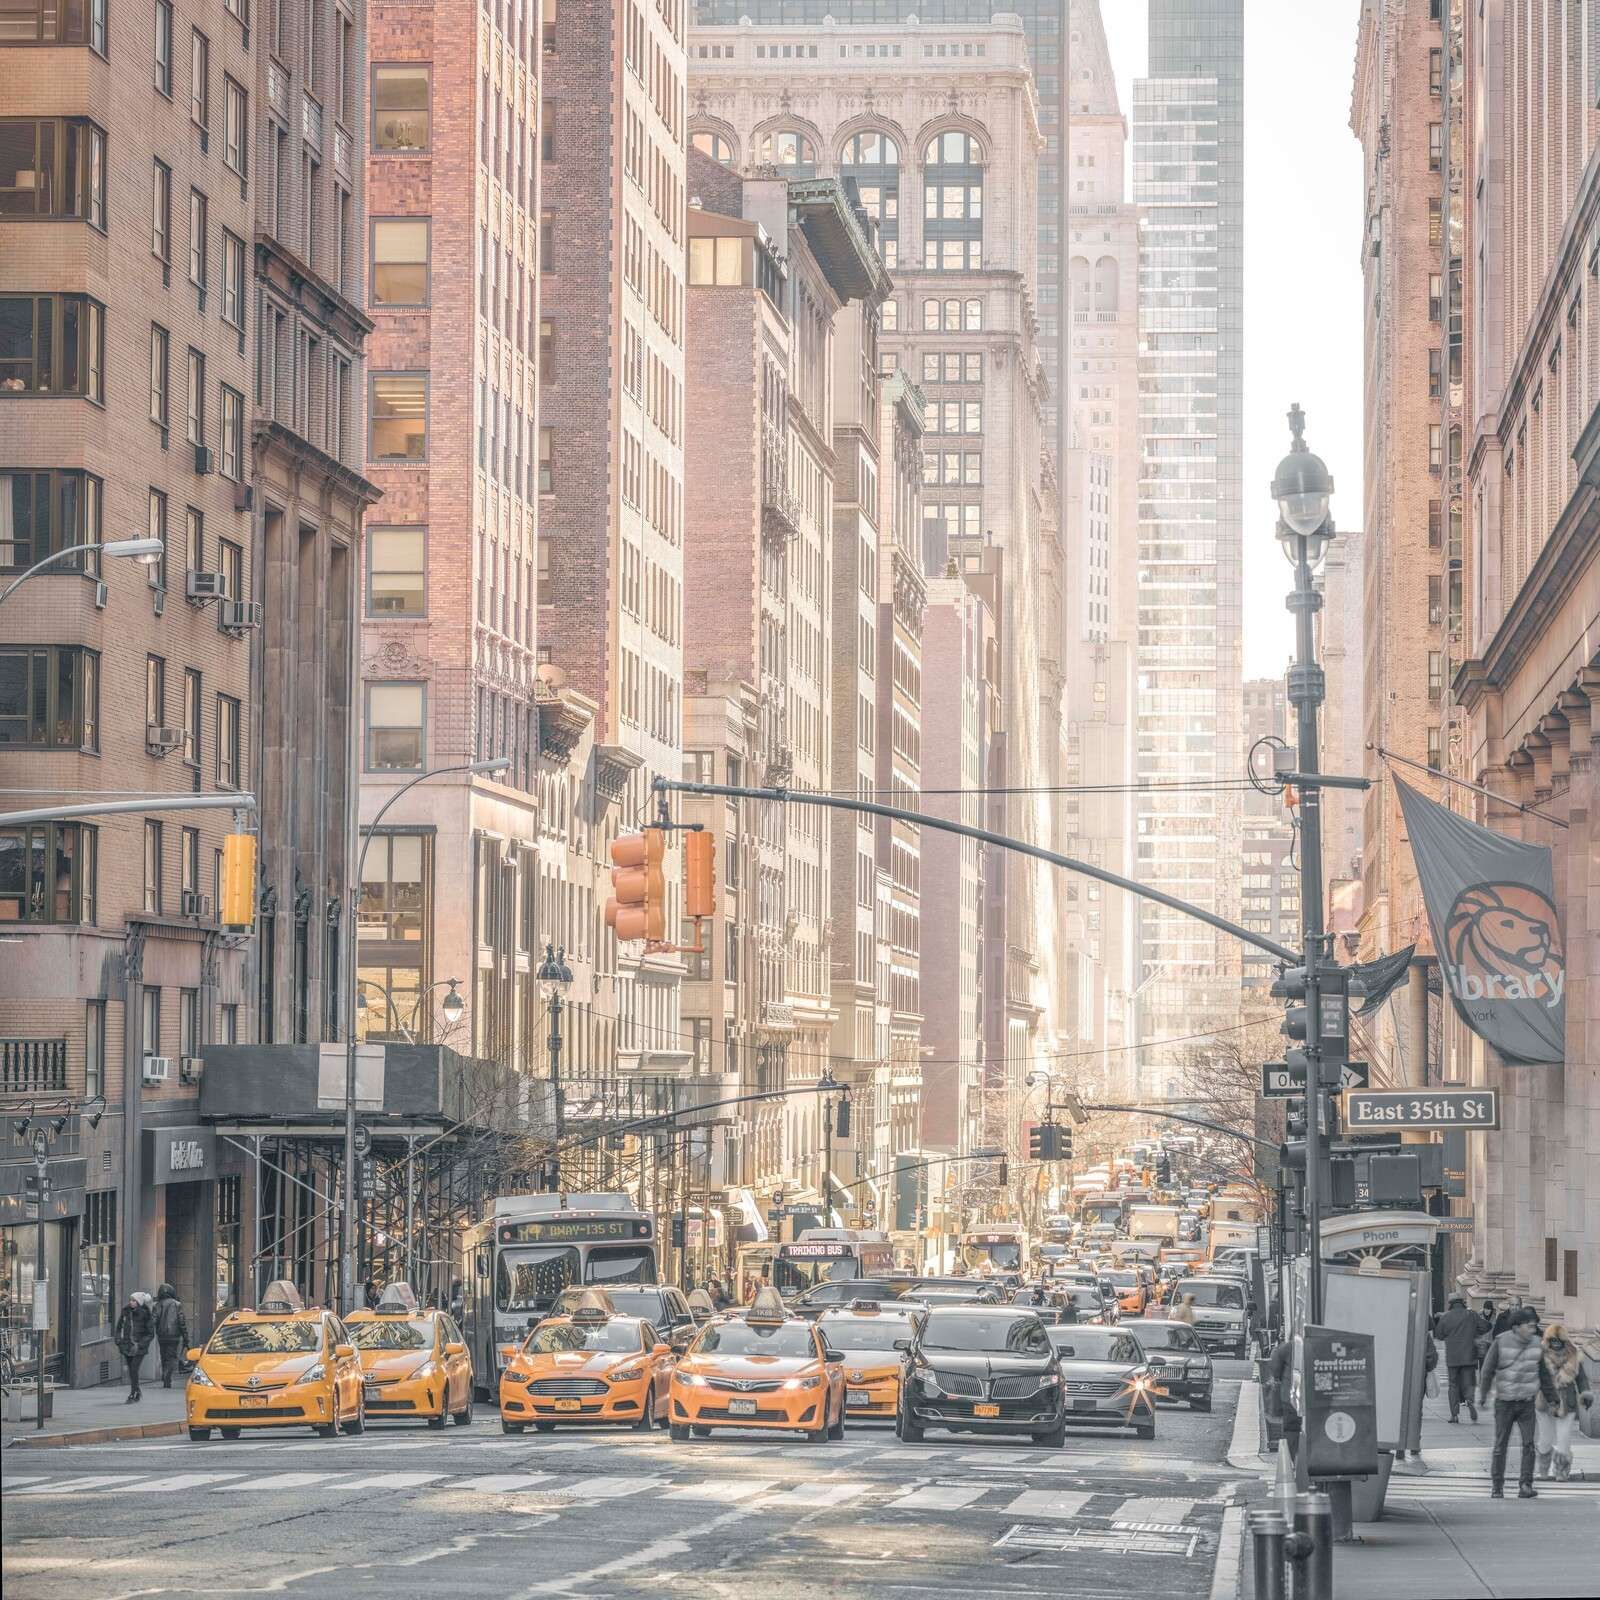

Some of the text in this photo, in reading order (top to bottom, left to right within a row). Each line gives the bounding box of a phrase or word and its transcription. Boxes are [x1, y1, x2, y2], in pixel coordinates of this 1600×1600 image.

[1449, 965, 1565, 1008] ibrary
[1472, 1009, 1497, 1021] York
[1357, 1100, 1485, 1120] East 35th St
[1359, 1188, 1369, 1198] 34
[609, 1223, 624, 1234] ST
[1363, 1231, 1399, 1241] Phone
[788, 1245, 843, 1256] TRAINING BUS
[1339, 1358, 1366, 1366] Central
